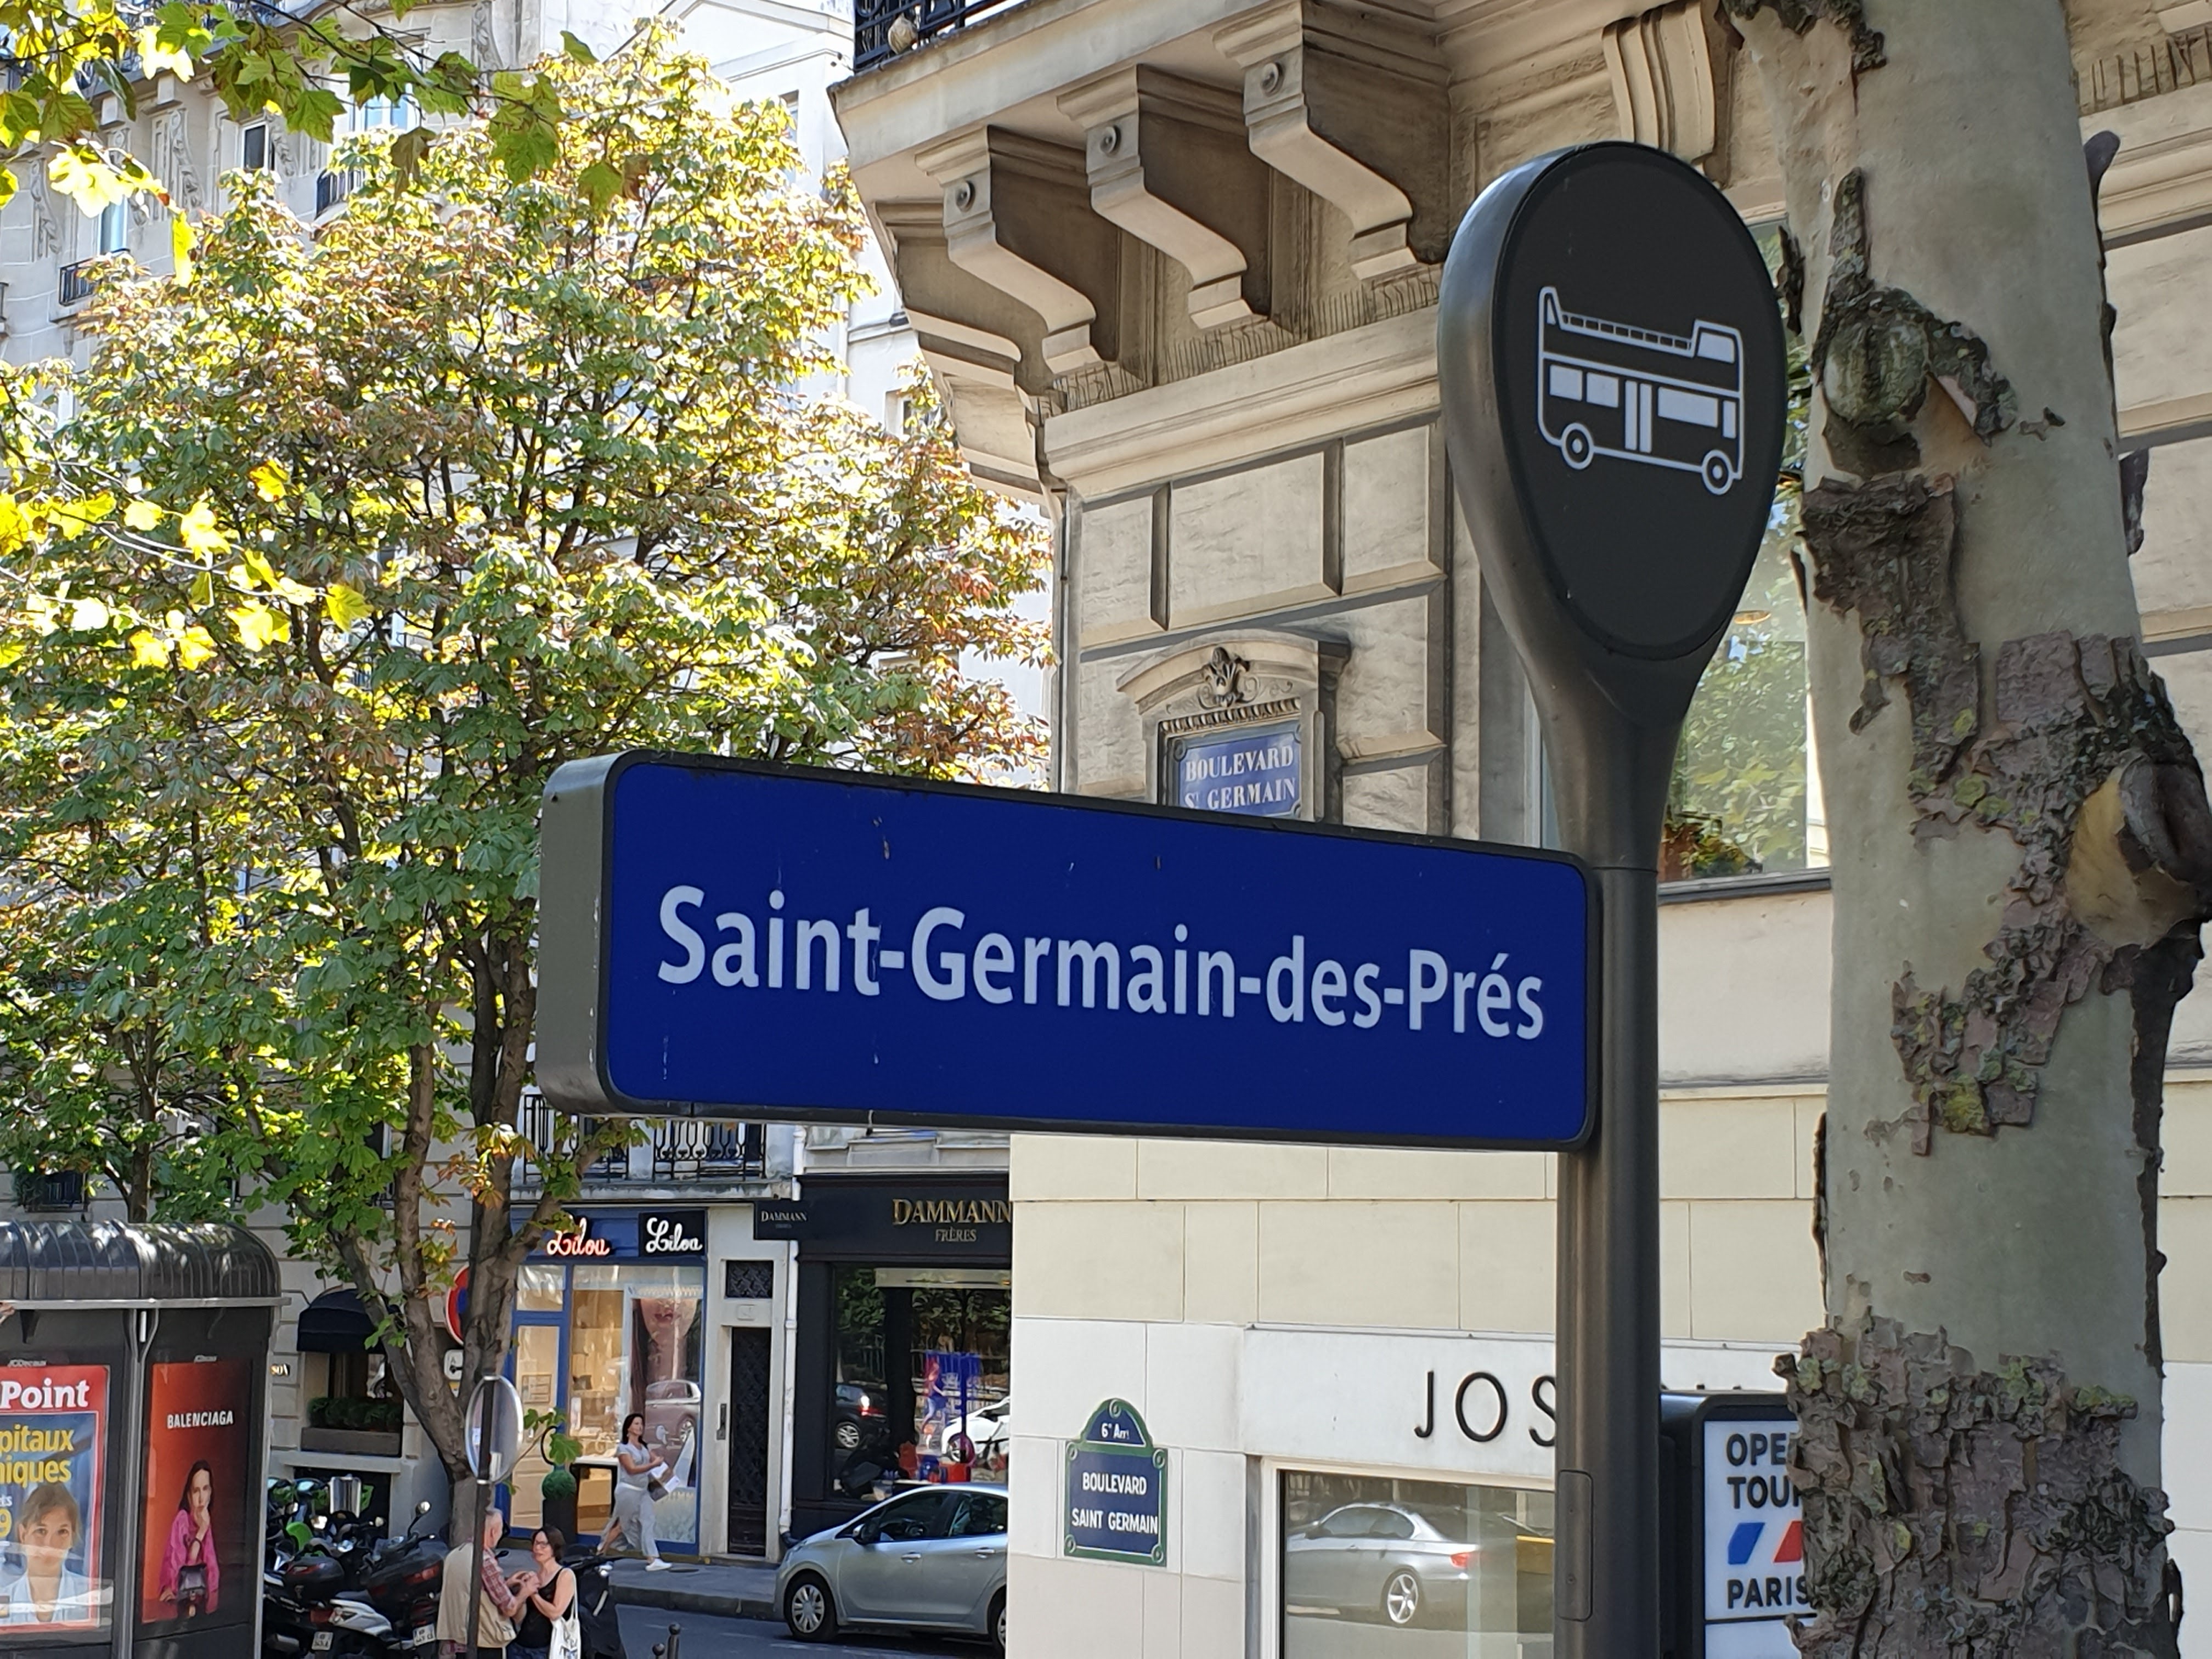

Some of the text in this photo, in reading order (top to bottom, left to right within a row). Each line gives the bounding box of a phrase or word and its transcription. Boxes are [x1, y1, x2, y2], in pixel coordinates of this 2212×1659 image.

[1185, 745, 1294, 782] BOULEVARD
[1207, 777, 1295, 810] GERMAIN
[658, 885, 1543, 1040] Saint-Germain-des-Prés
[893, 1199, 1011, 1225] DAMMANN
[935, 1226, 977, 1242] FRÈRES
[0, 1378, 89, 1409] Point
[167, 1410, 234, 1429] BALENCIAGA
[1414, 1370, 1556, 1447] JOS
[0, 1424, 74, 1452] pitaux
[1082, 1472, 1147, 1495] BOULEVARD
[1072, 1508, 1159, 1534] SAINT GERMAIN
